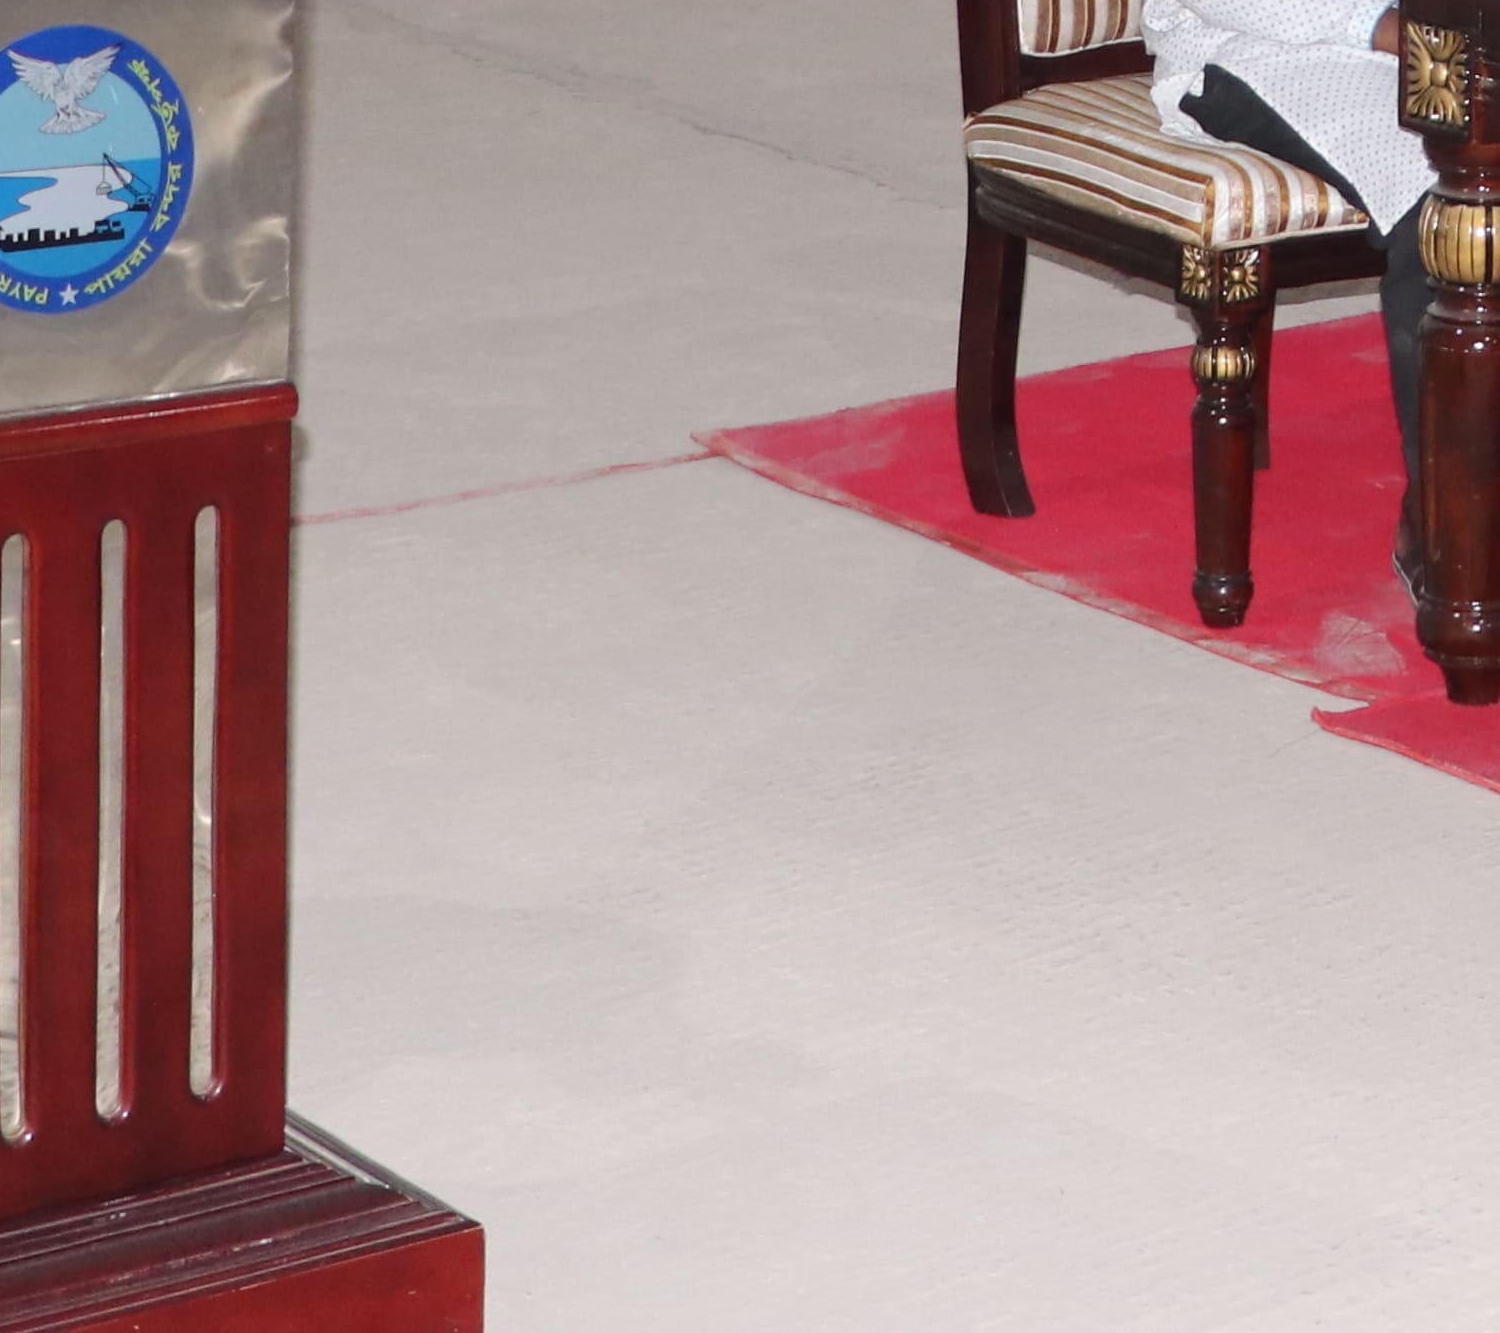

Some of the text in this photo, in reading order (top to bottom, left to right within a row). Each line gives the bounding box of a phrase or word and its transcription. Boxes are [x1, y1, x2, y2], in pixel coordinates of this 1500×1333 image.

[84, 59, 184, 297] পায়রা বন্দর কর্তৃপক্ষ
